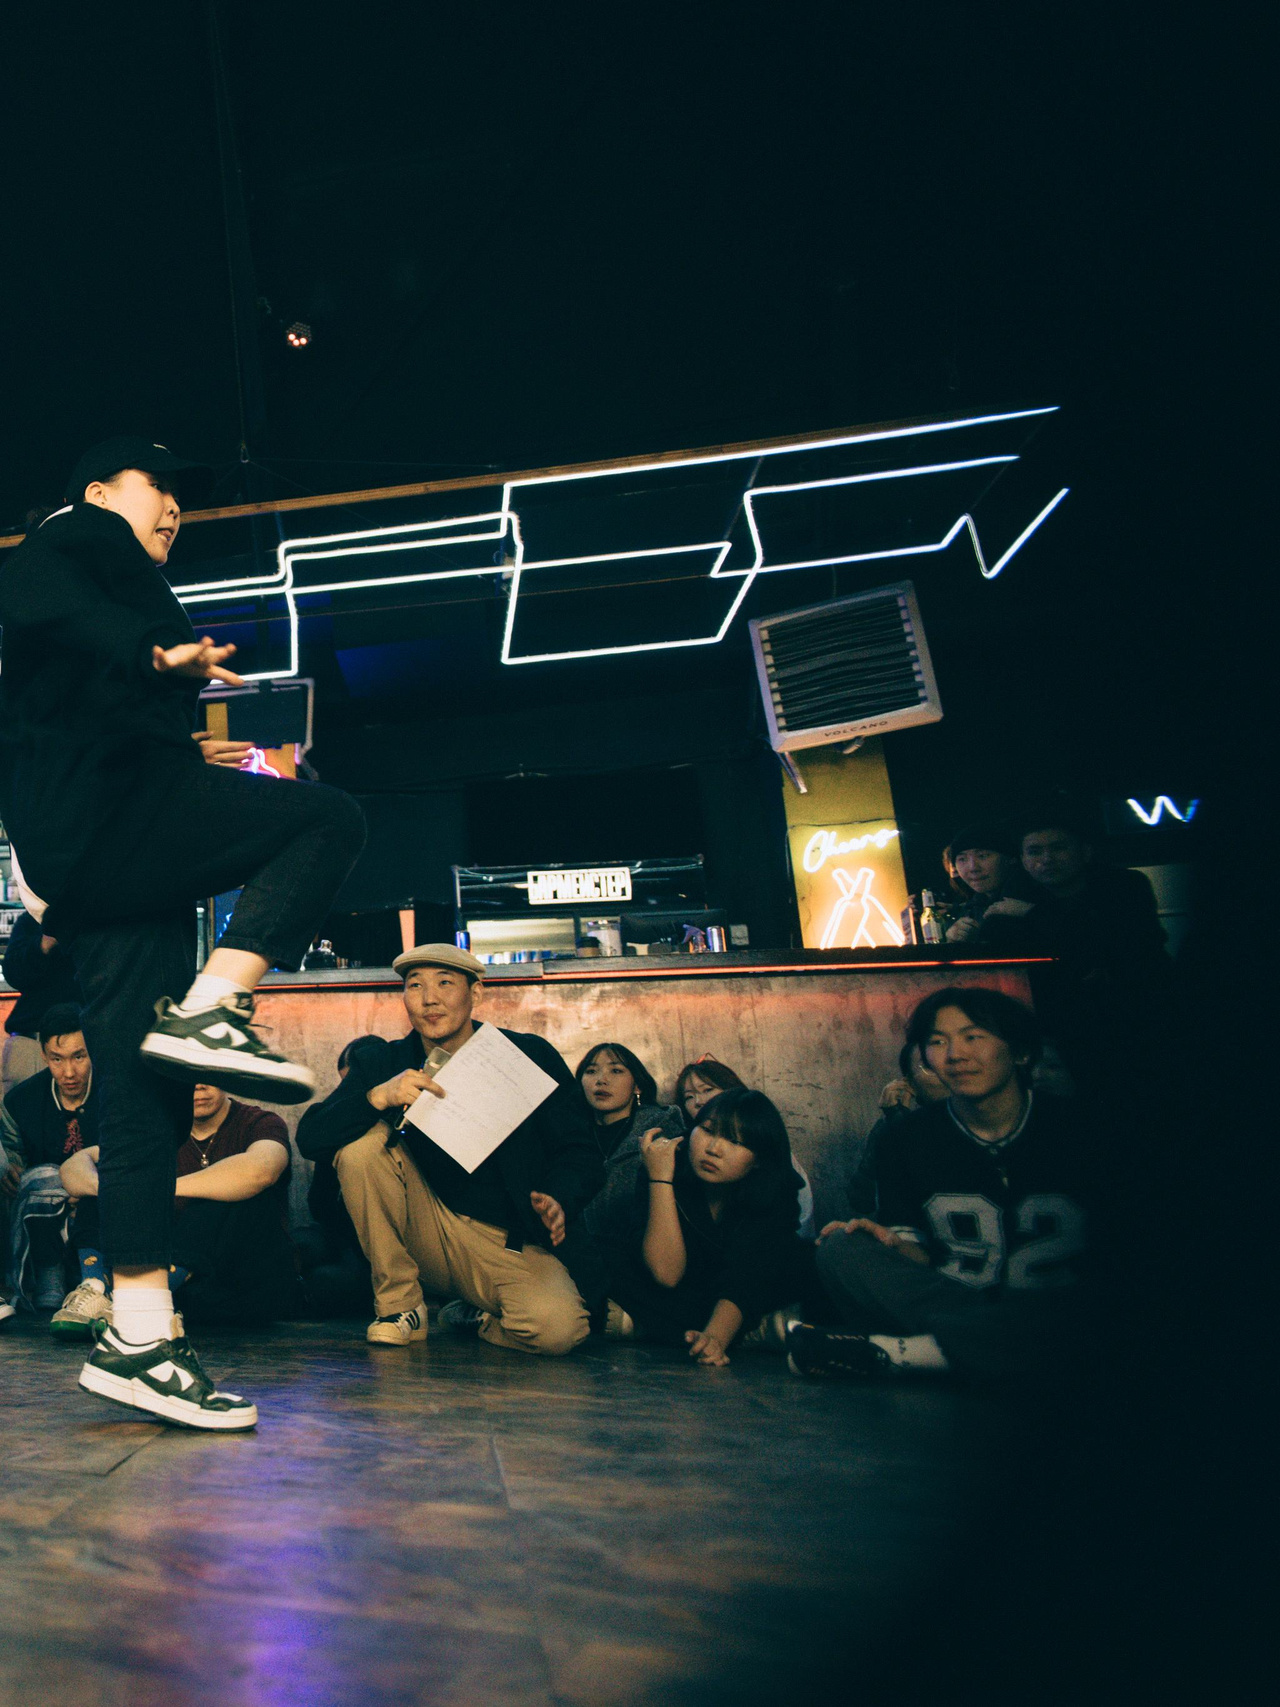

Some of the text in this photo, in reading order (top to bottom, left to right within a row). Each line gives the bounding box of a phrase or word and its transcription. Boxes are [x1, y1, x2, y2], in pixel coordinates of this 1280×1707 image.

[824, 720, 889, 737] VOLCANO
[803, 828, 900, 873] Cheers
[923, 1192, 1084, 1289] 92
